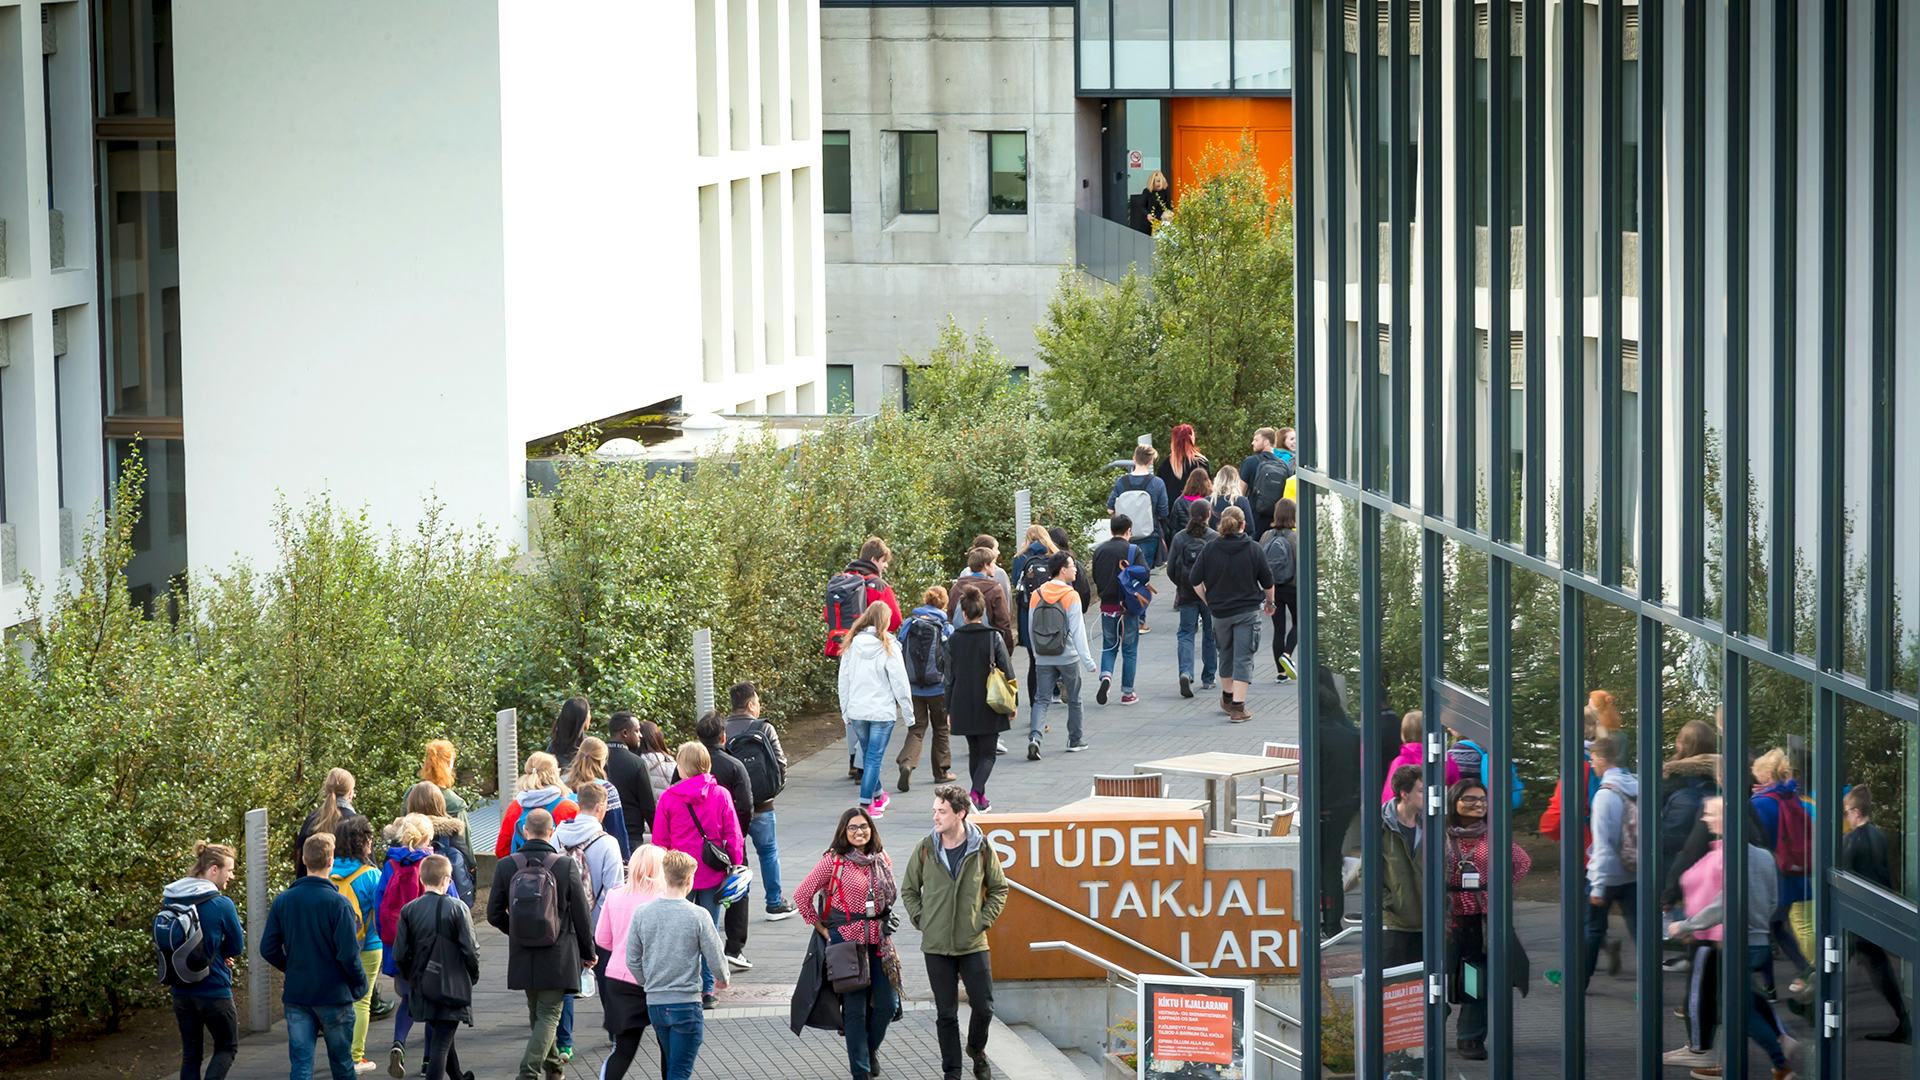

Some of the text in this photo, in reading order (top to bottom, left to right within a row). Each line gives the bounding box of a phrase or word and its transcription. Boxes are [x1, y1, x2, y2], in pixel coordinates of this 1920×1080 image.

[987, 823, 1198, 868] STÚDEN
[1078, 879, 1286, 919] TAKJAL
[1180, 929, 1298, 969] LARI
[1158, 996, 1179, 1008] KÍKTU
